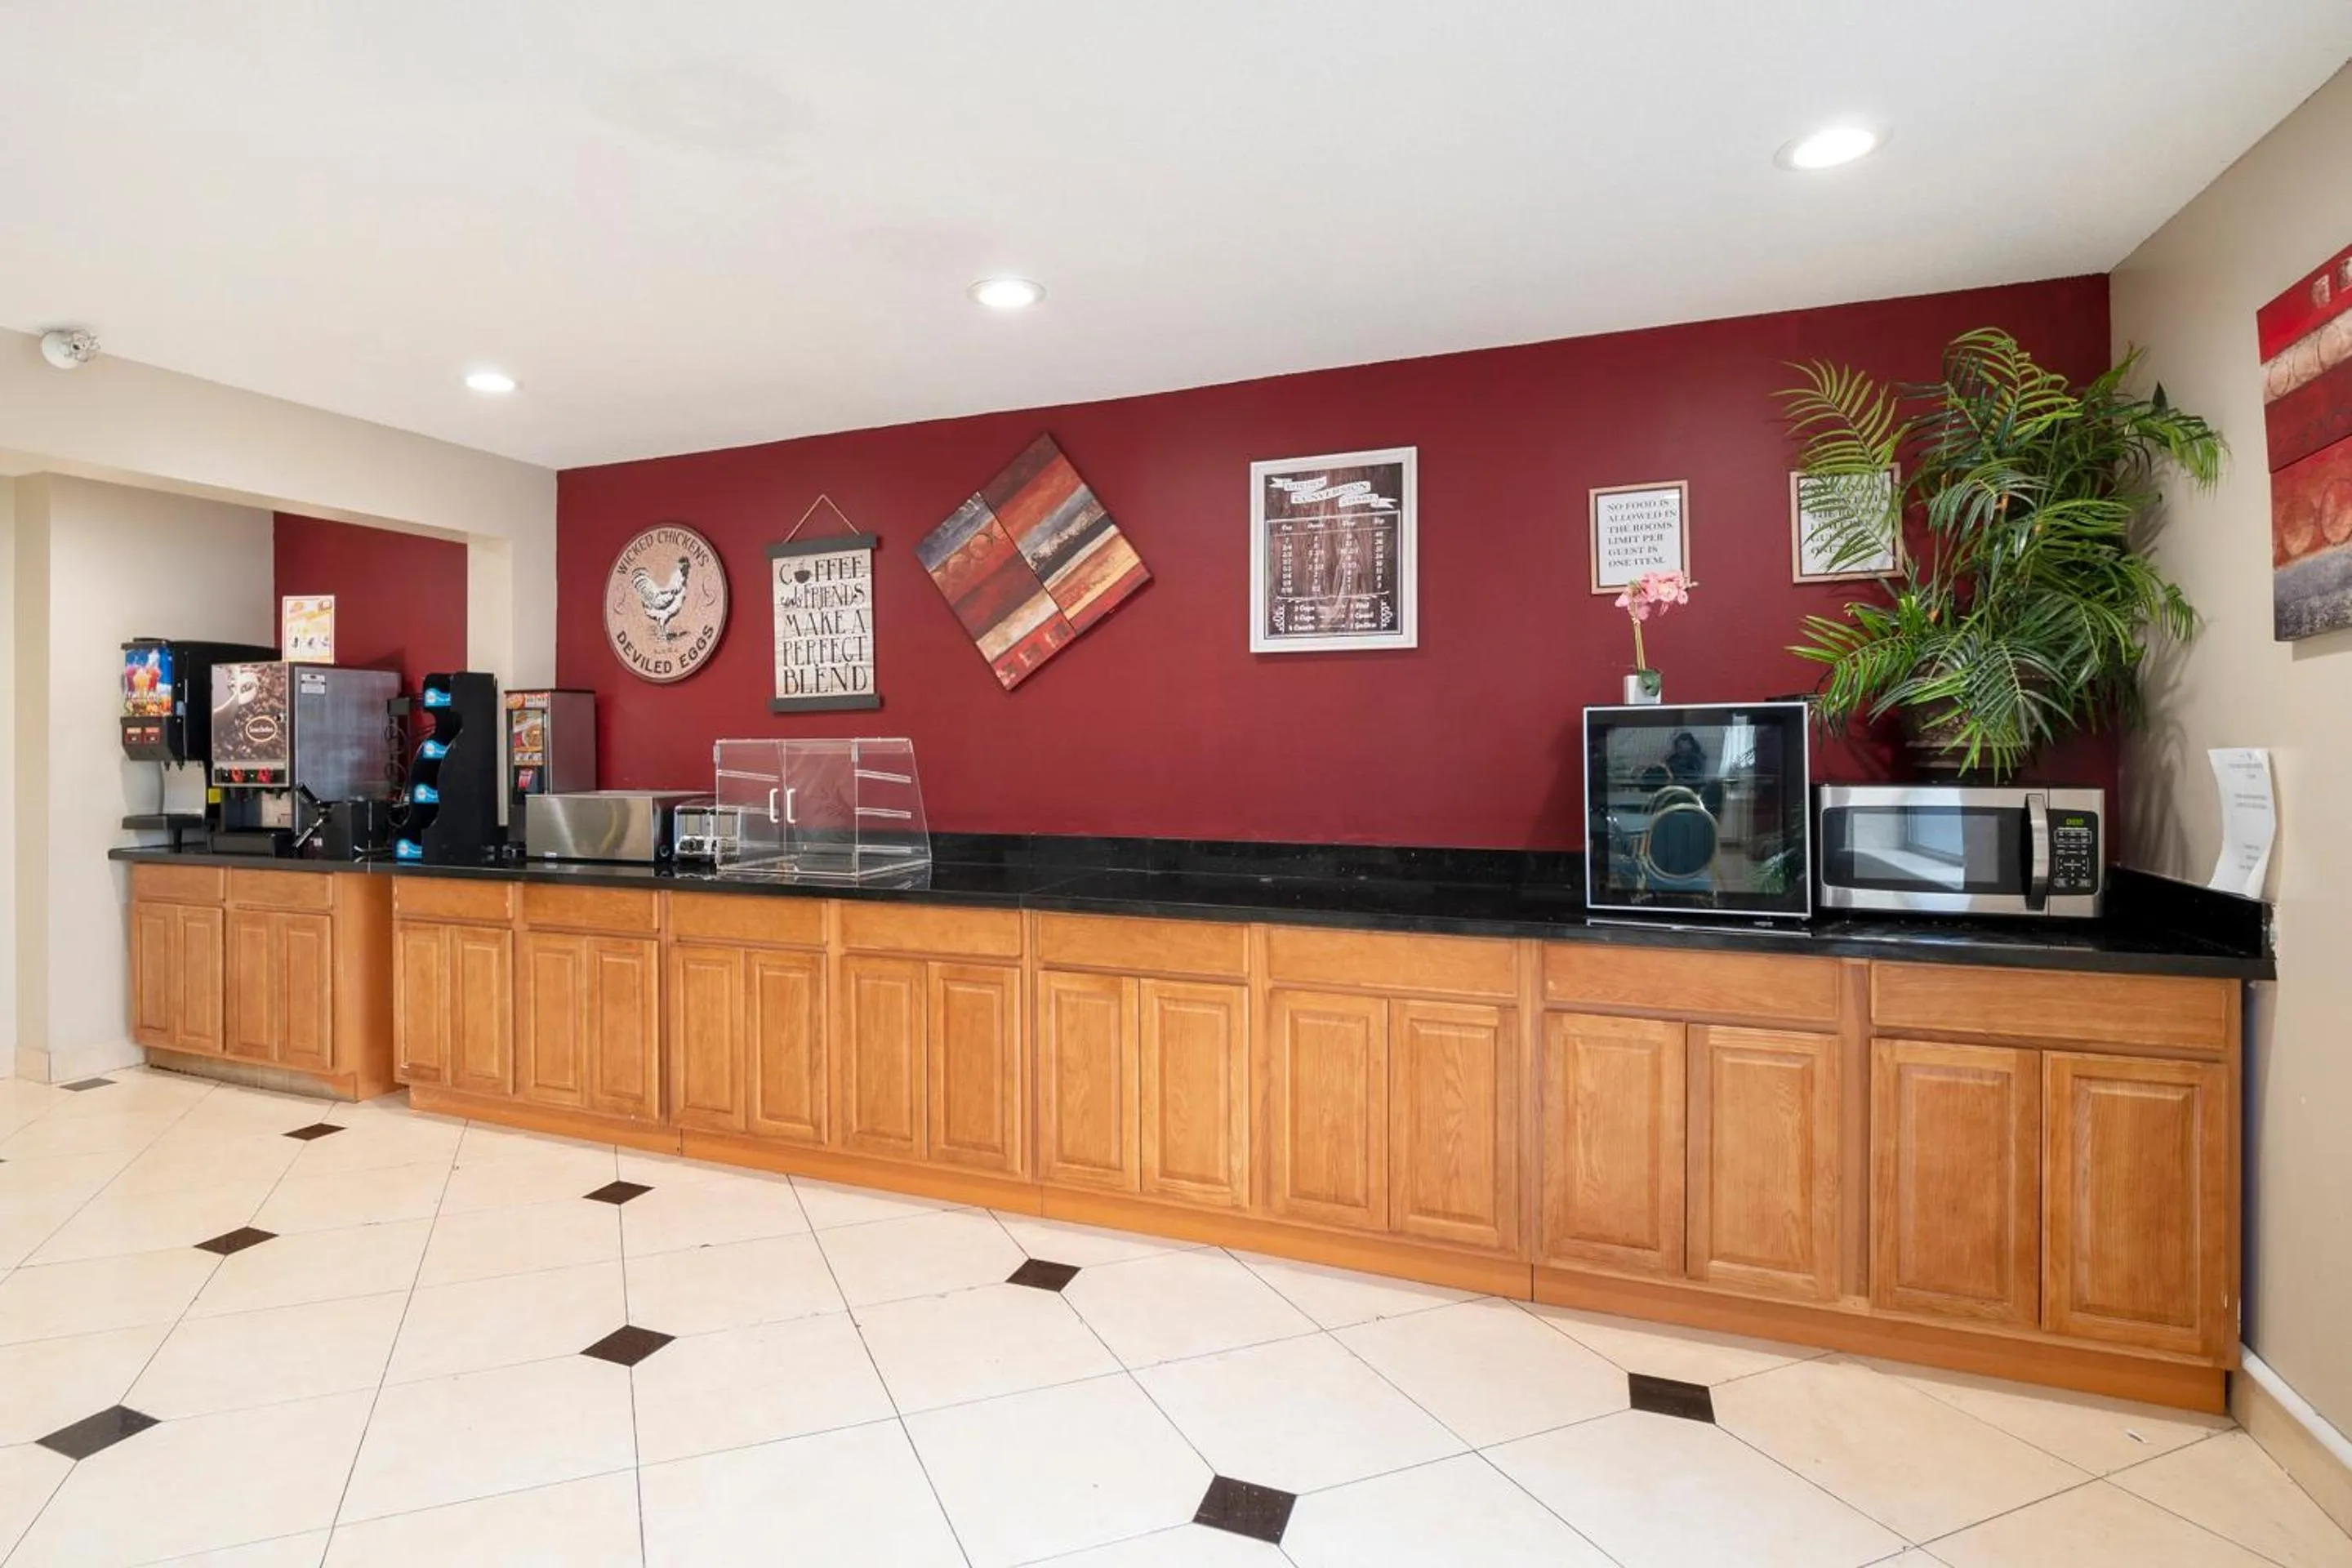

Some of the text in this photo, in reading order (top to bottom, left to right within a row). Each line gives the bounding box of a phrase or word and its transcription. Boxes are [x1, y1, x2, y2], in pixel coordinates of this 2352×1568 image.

[1606, 499, 1669, 511] NO FOOD IS
[1608, 509, 1677, 523] ALLOWED IN
[1607, 522, 1673, 533] THE ROOMS
[1607, 533, 1663, 545] LIMIT PER
[617, 529, 710, 575] WICKED CHICKENS
[1607, 546, 1658, 556] GUEST IS
[1607, 559, 1632, 568] ONE
[778, 555, 866, 586] CFFEE
[804, 583, 866, 611] FRIENDS
[783, 608, 866, 639] MAKE A
[617, 624, 715, 675] DEVILED EGGS
[783, 635, 868, 667] PERFECT
[783, 664, 868, 694] BLEND
